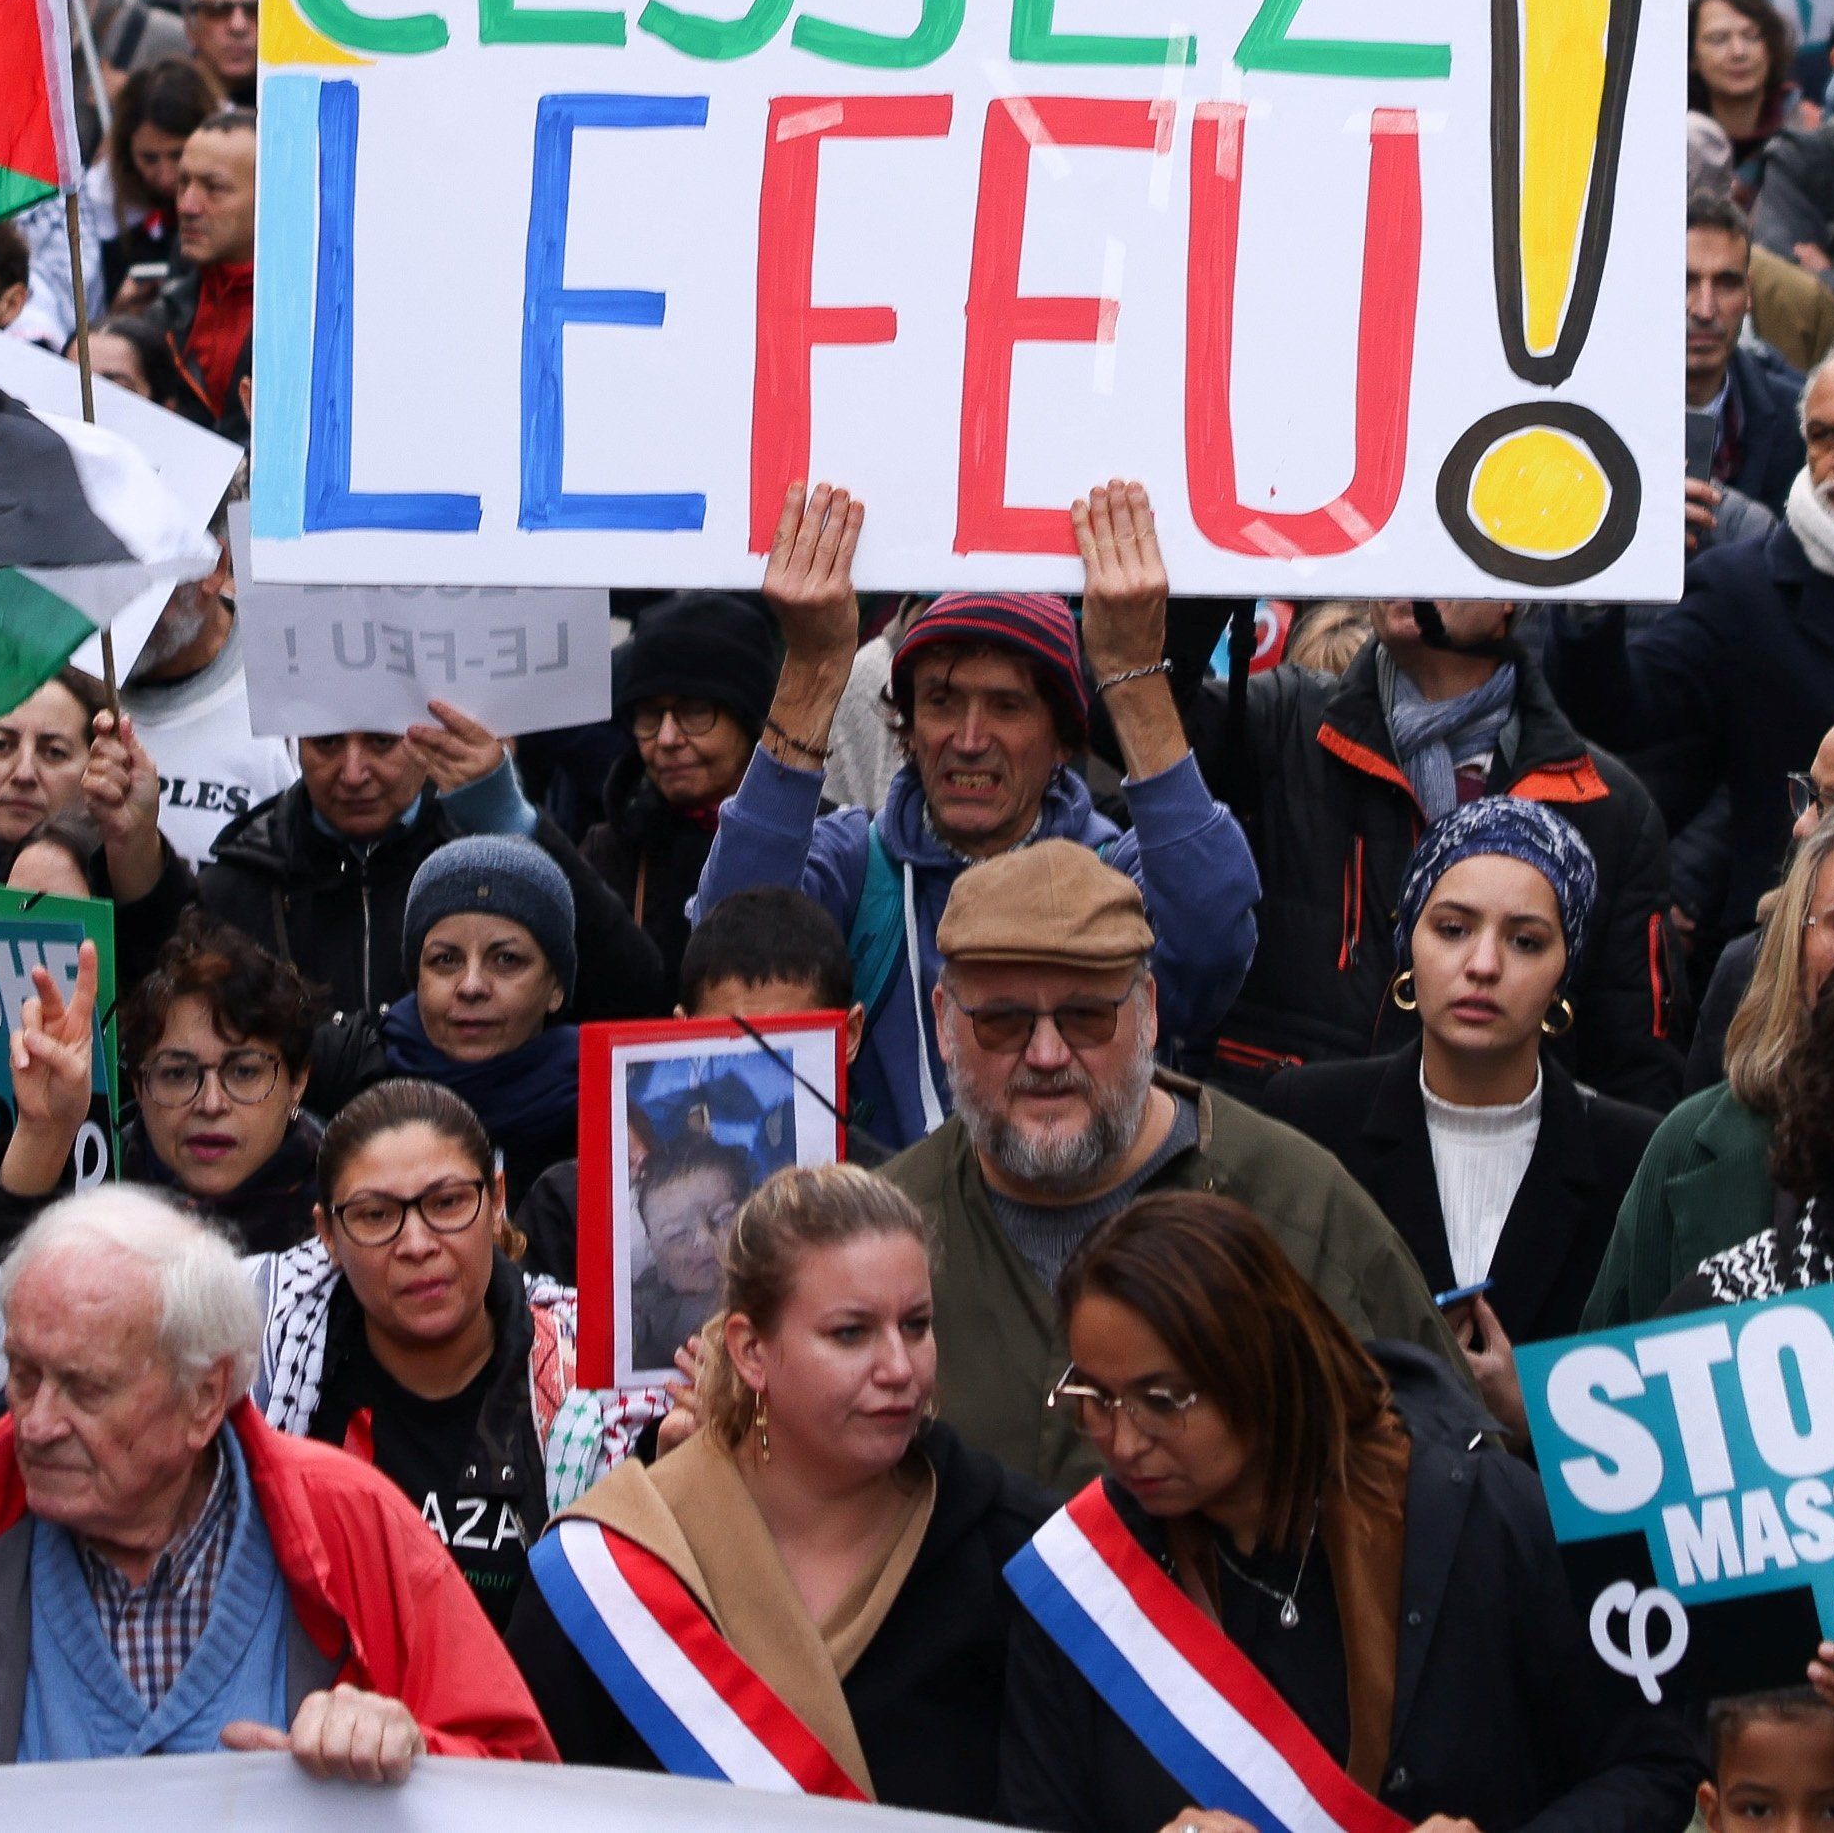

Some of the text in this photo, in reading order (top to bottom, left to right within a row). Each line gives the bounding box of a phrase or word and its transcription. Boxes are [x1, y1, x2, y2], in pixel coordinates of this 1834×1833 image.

[302, 78, 709, 533] LE
[748, 92, 1422, 562] FEU
[420, 1490, 526, 1552] AZA
[464, 1567, 513, 1590] mour
